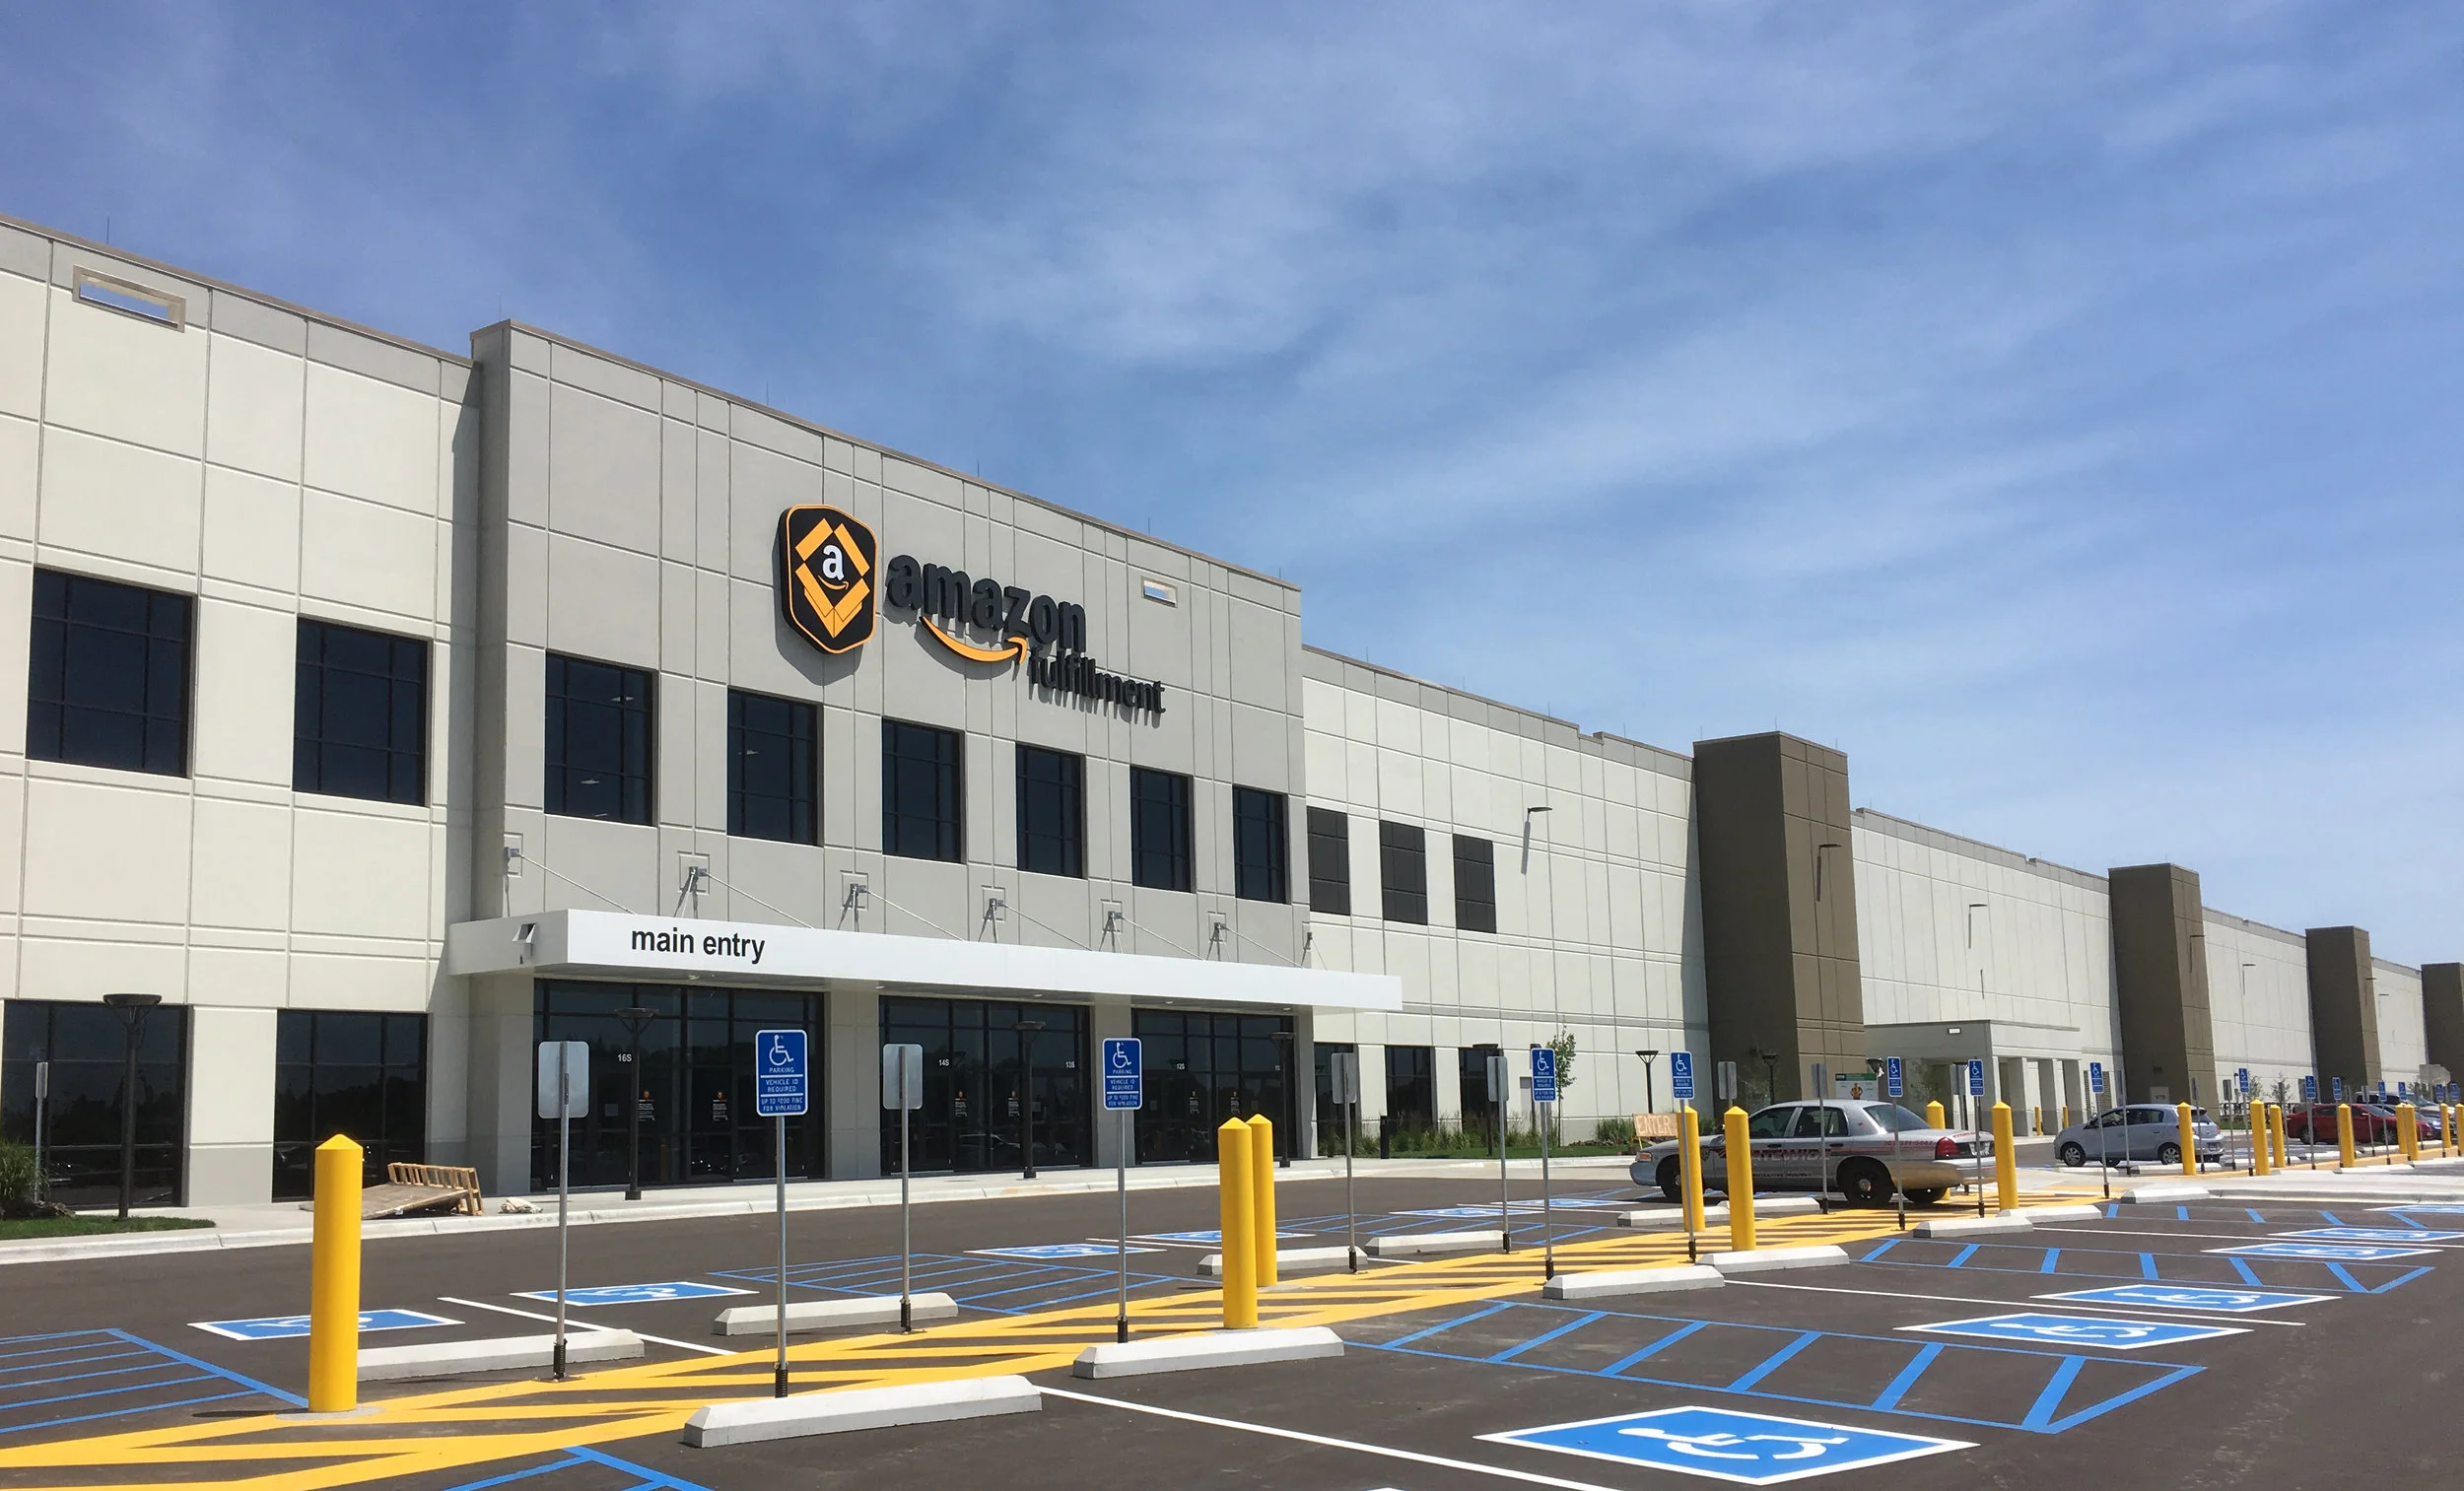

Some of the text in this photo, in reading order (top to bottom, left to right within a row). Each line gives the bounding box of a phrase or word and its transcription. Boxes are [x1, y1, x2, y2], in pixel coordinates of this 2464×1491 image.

[885, 554, 1086, 652] amazon
[1029, 645, 1166, 714] fulfillment
[632, 926, 766, 965] main entry
[617, 1053, 633, 1062] 16S
[1636, 1115, 1673, 1136] ENTER
